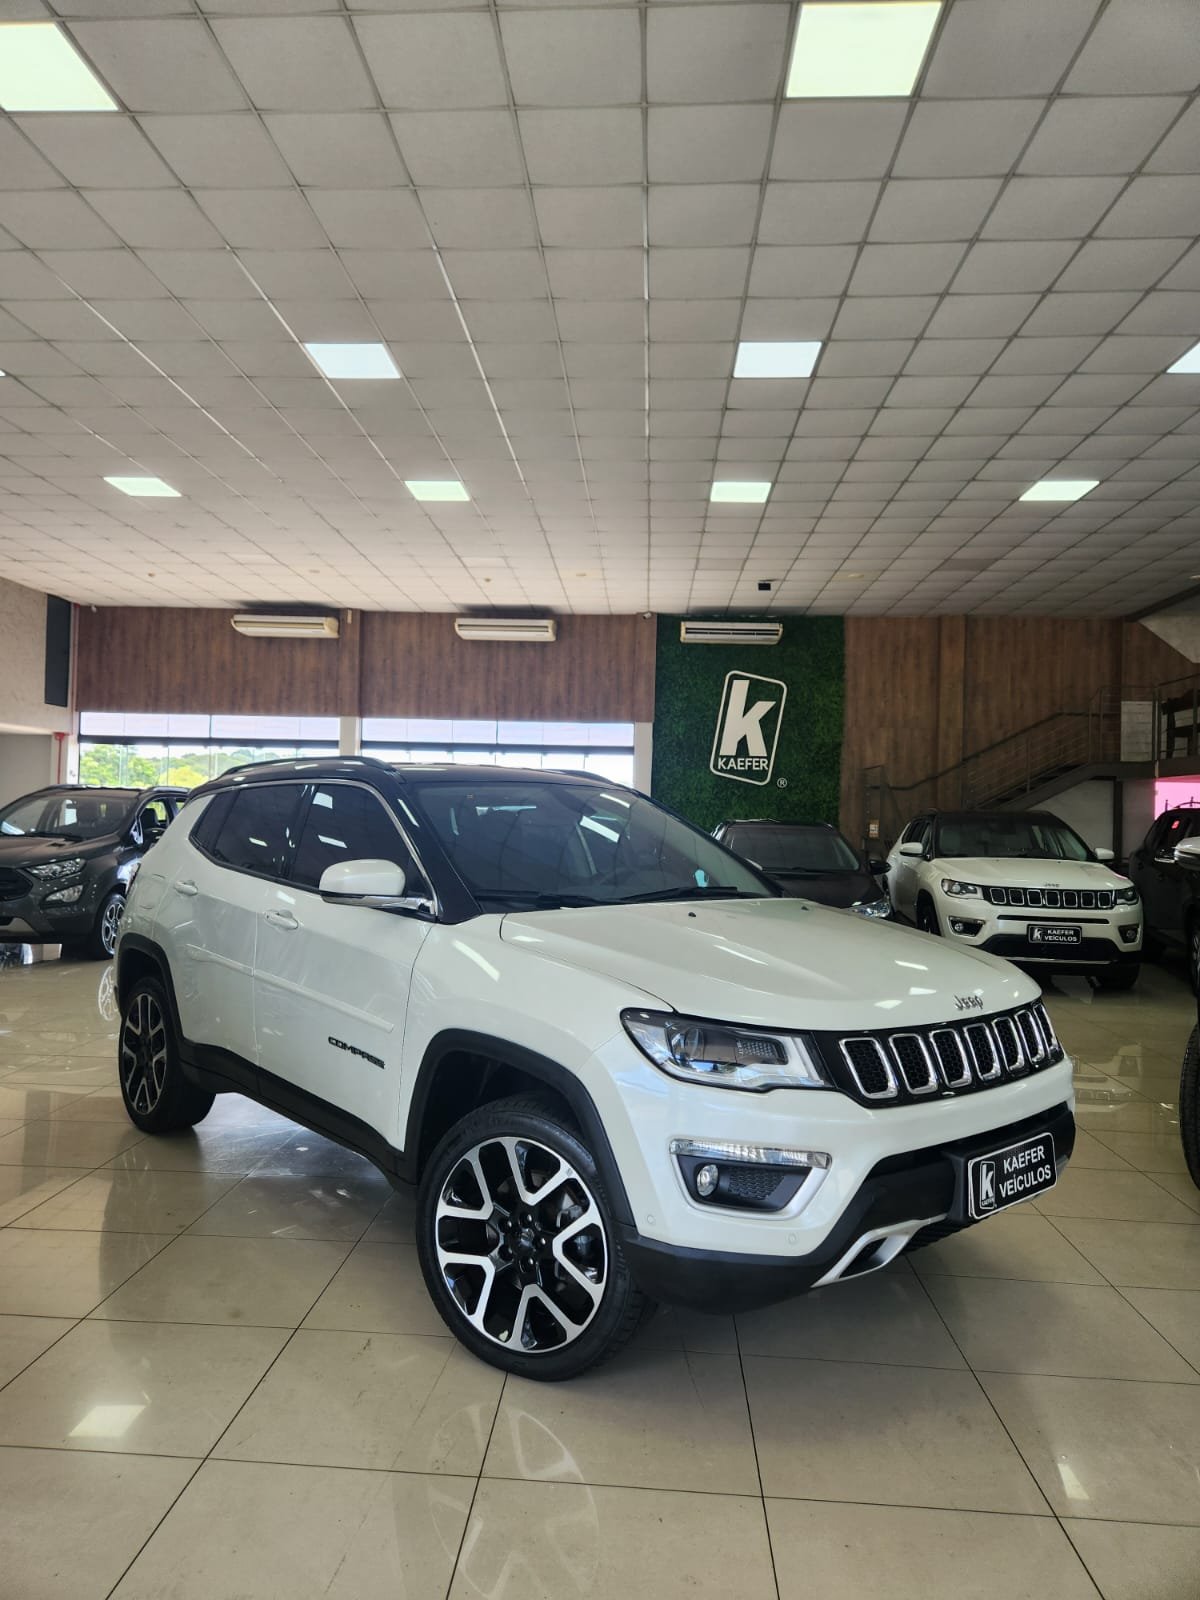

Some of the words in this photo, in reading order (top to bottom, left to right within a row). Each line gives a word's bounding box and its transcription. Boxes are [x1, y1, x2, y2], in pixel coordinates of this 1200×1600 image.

[717, 757, 769, 771] KAEFER
[327, 1036, 386, 1070] COMPASS
[1003, 1145, 1046, 1175] KAEFER
[999, 1164, 1052, 1199] VEÍCULOS
